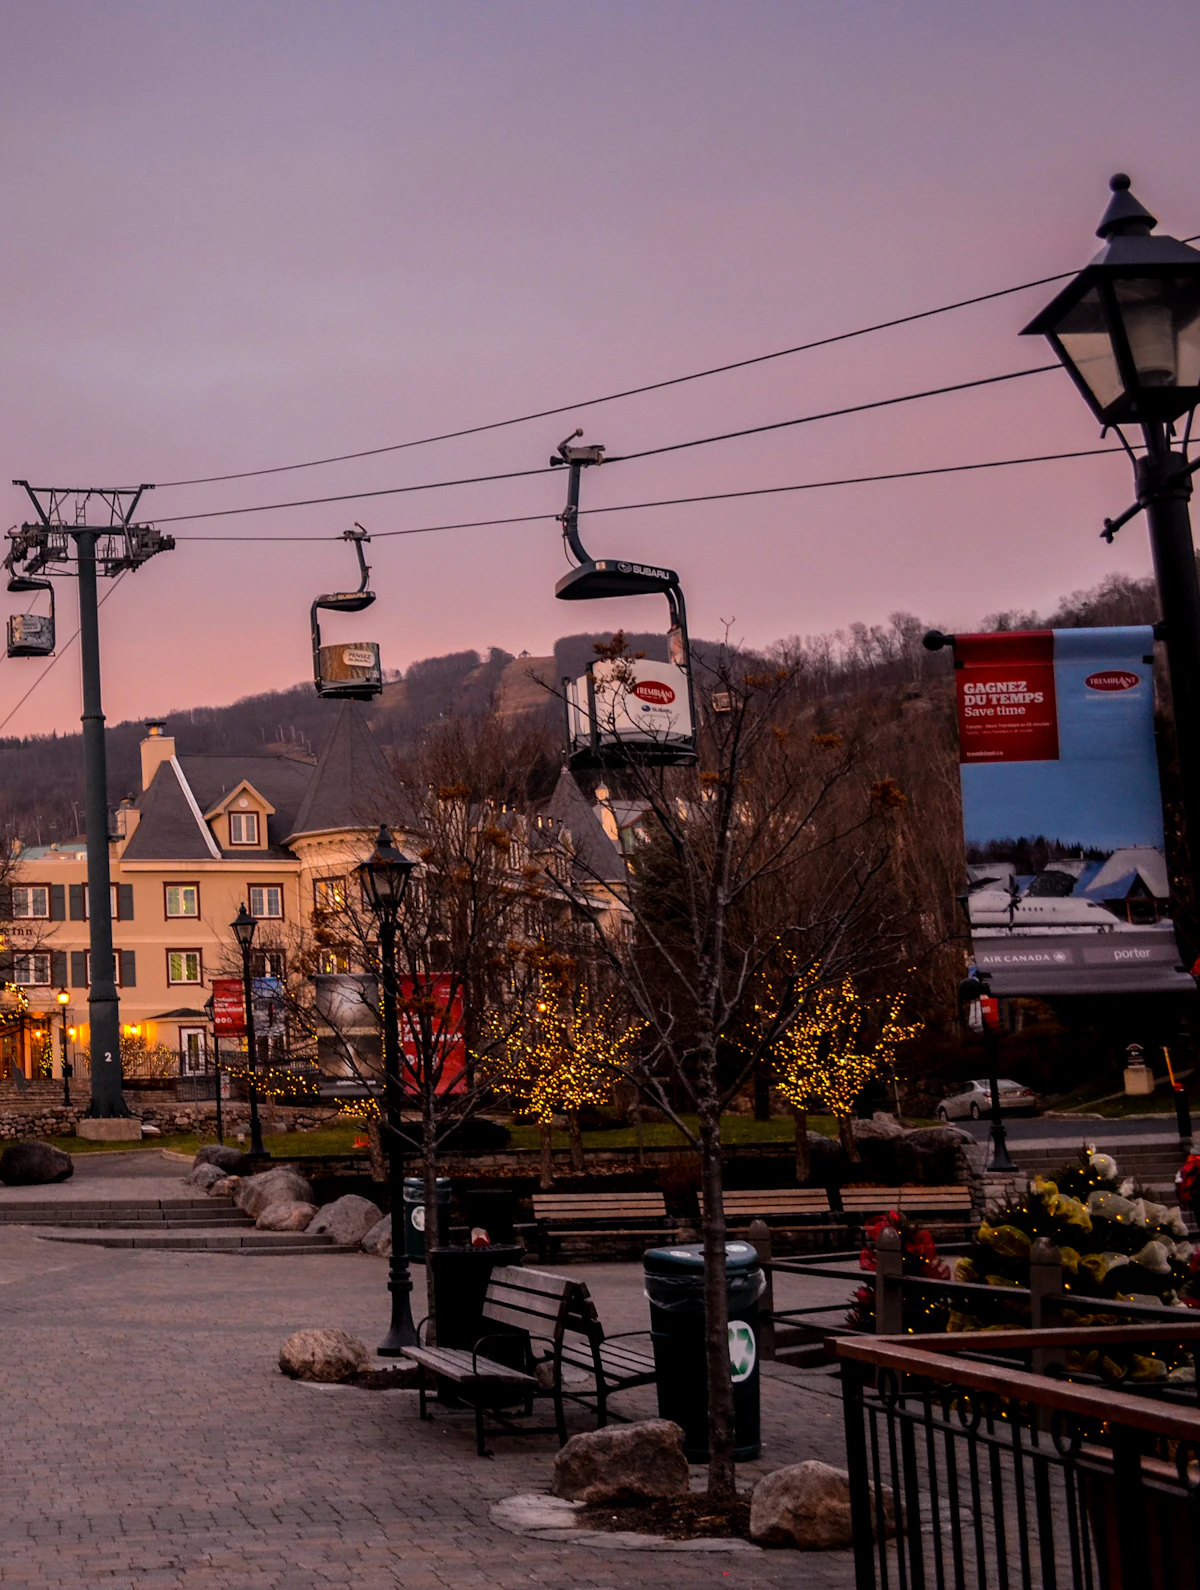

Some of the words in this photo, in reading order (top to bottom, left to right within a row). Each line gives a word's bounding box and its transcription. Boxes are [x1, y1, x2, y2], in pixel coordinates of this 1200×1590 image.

[632, 565, 670, 580] SUBARU
[348, 652, 371, 660] PENSEZ
[963, 681, 1027, 694] GAGNEZ
[1090, 676, 1136, 688] TREMBLANT
[636, 687, 673, 703] TREMBLANT
[964, 694, 987, 706] DU
[988, 691, 1044, 705] TEMPS
[964, 707, 995, 717] Save
[996, 705, 1026, 715] time
[983, 954, 1002, 963] AIR
[1003, 953, 1051, 963] CANADA
[1113, 948, 1151, 961] porter
[104, 1051, 112, 1063] 2
